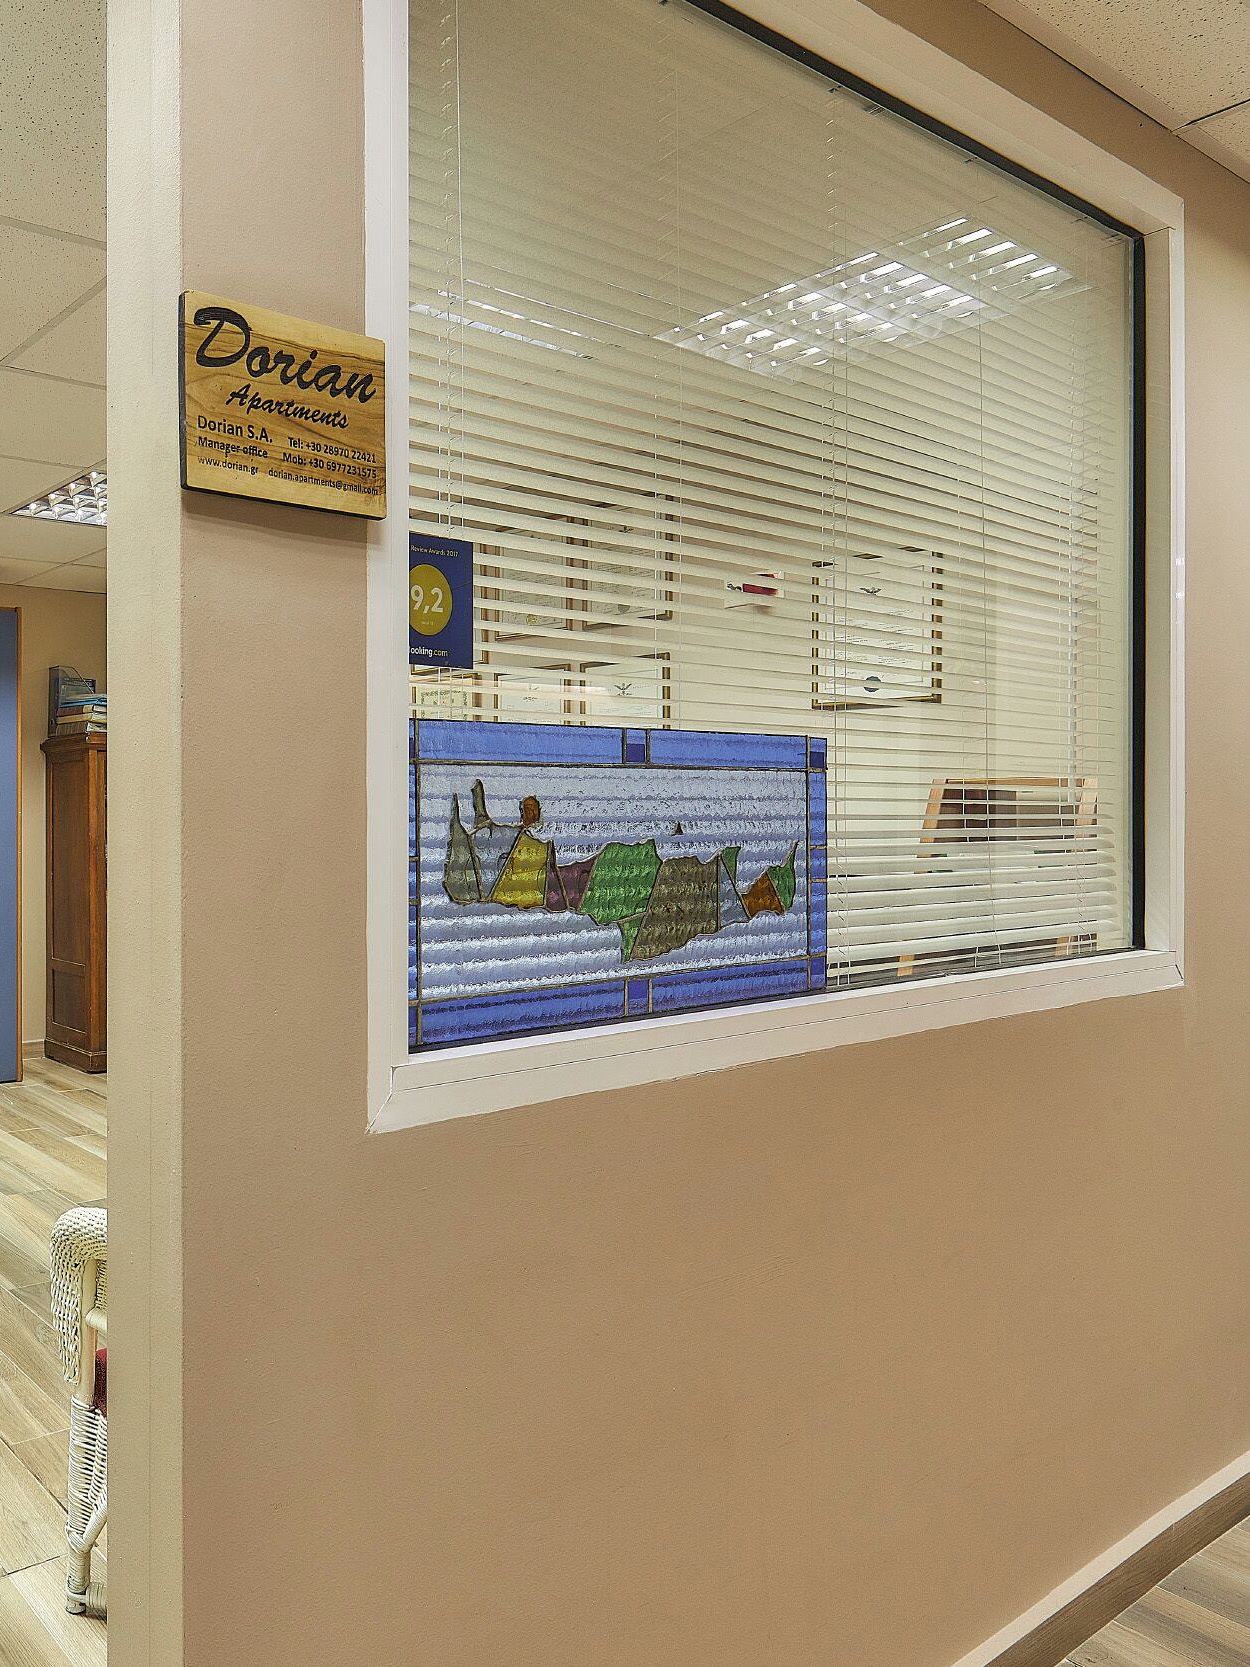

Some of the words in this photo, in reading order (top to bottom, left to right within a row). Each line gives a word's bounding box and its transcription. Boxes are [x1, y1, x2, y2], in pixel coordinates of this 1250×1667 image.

[194, 307, 377, 404] Dorian
[225, 383, 349, 429] Apartments
[197, 415, 244, 437] Dorian
[247, 425, 273, 443] S.A.
[198, 436, 240, 456] Manager
[242, 445, 268, 458] office
[288, 437, 303, 449] Tel:
[305, 442, 322, 453] +30
[323, 444, 349, 458] 28970
[351, 449, 376, 464] 22421
[197, 456, 259, 475] www.dorian.gr
[282, 452, 306, 466] Mob:
[308, 458, 324, 470] +30
[326, 461, 377, 479] 6977231575
[410, 544, 428, 553] Review
[428, 547, 446, 556] Awards
[446, 550, 459, 558] 2017
[410, 584, 444, 614] 9,2
